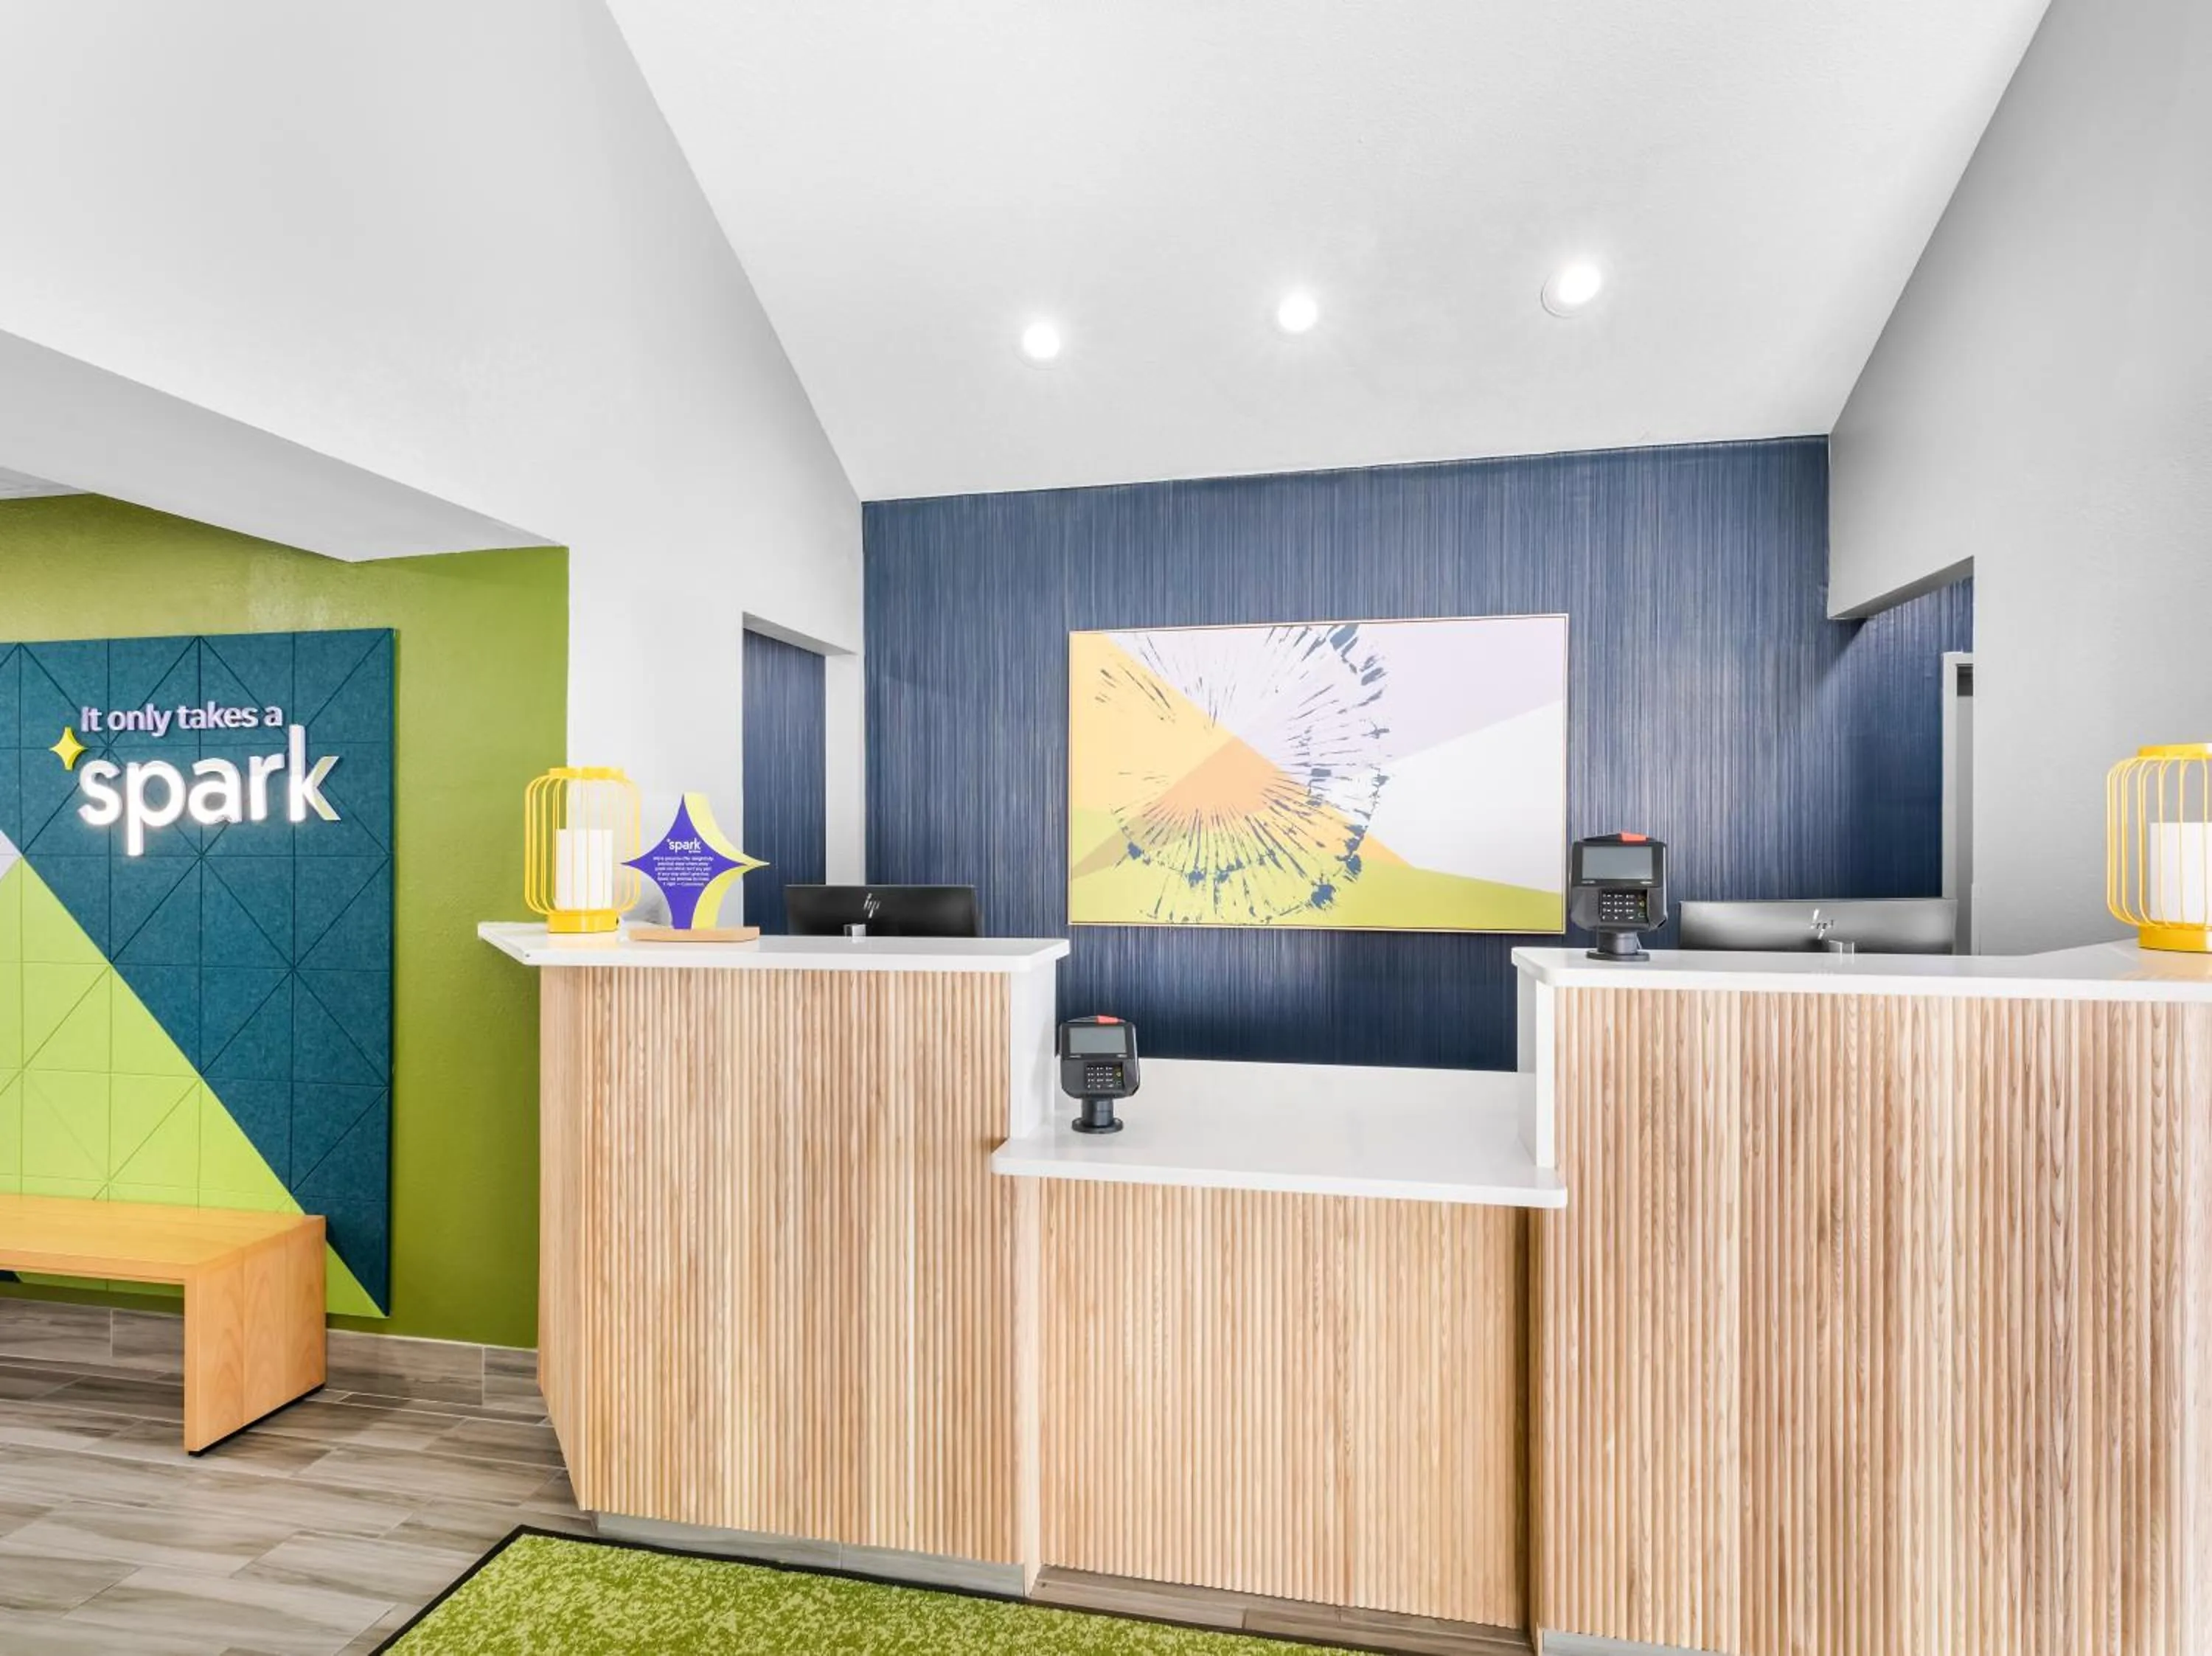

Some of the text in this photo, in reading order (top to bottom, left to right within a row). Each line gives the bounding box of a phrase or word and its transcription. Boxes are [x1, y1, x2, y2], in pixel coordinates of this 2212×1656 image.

[80, 700, 282, 737] It only takes a
[78, 725, 341, 856] spark
[669, 838, 701, 853] spark
[863, 892, 880, 919] hp
